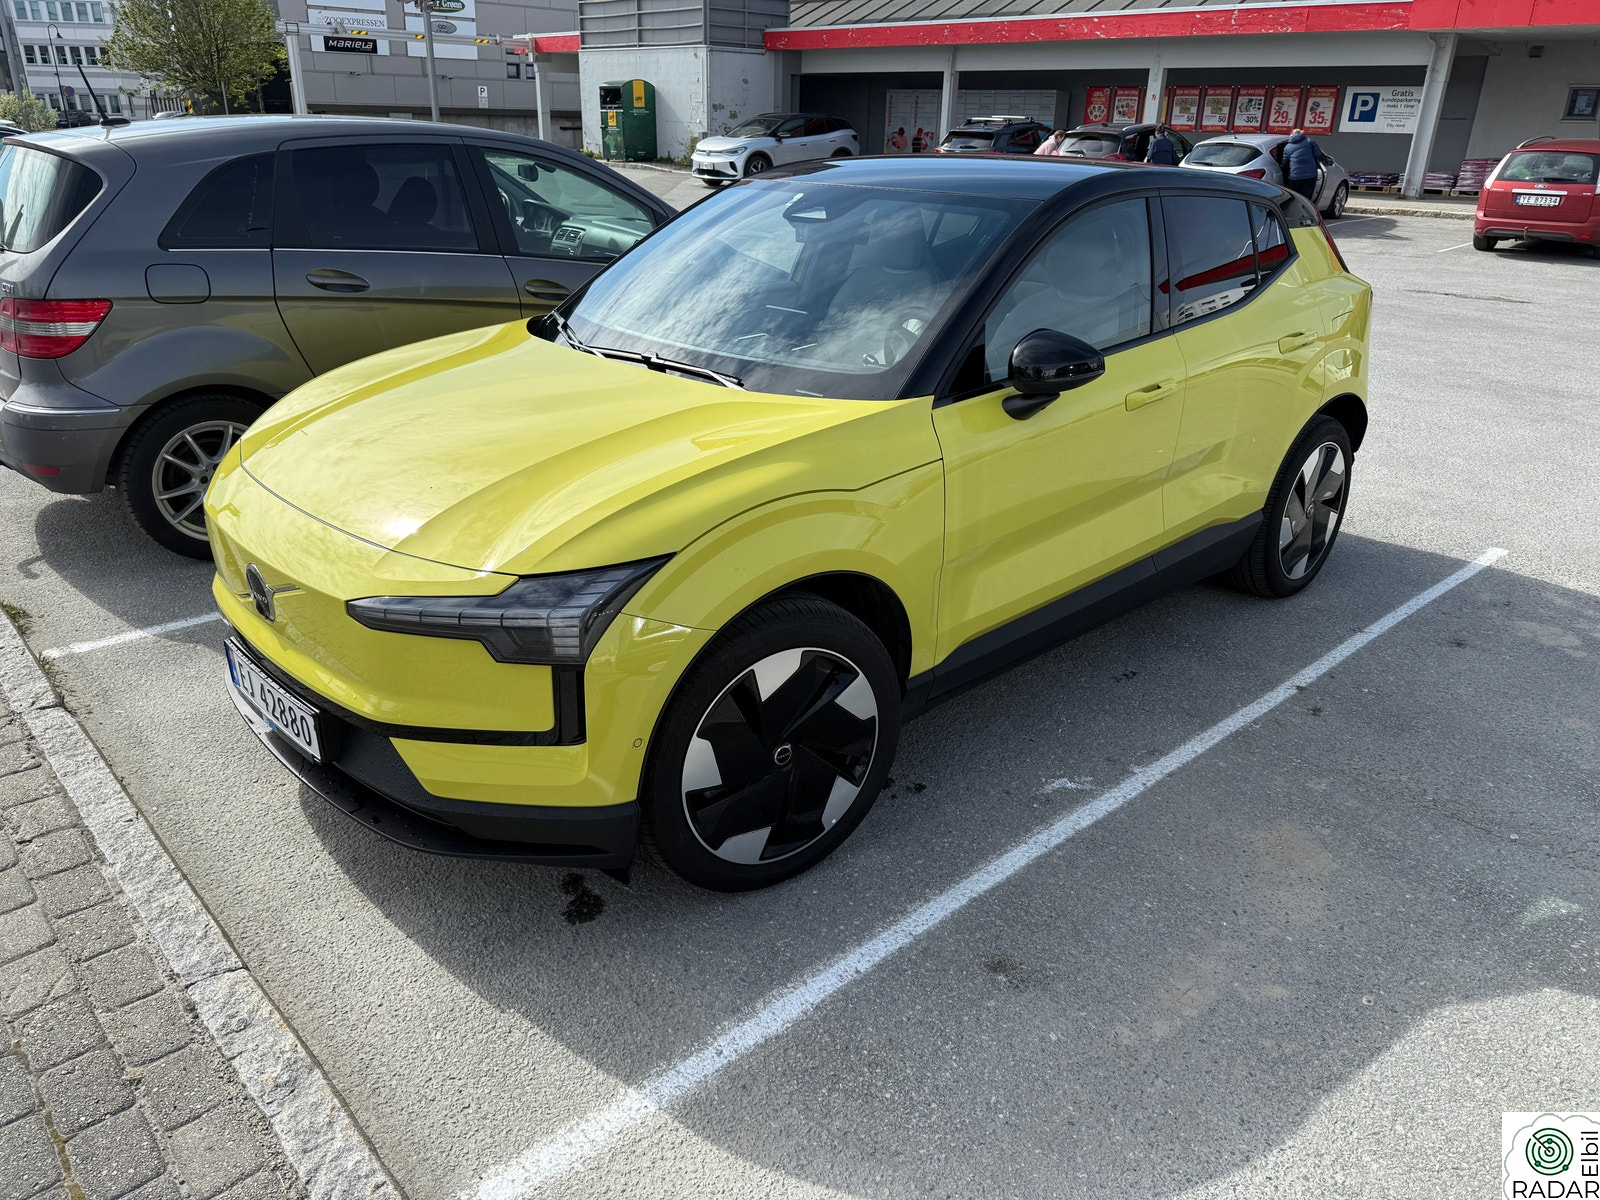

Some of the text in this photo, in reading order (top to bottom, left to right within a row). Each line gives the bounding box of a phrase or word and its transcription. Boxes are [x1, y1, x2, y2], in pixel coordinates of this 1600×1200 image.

[480, 87, 486, 96] P
[1391, 89, 1414, 97] Gratis
[1353, 95, 1375, 120] P
[1186, 115, 1195, 123] 50
[1218, 115, 1227, 123] 50
[1534, 196, 1558, 204] 87334
[237, 660, 312, 747] EJ 42880
